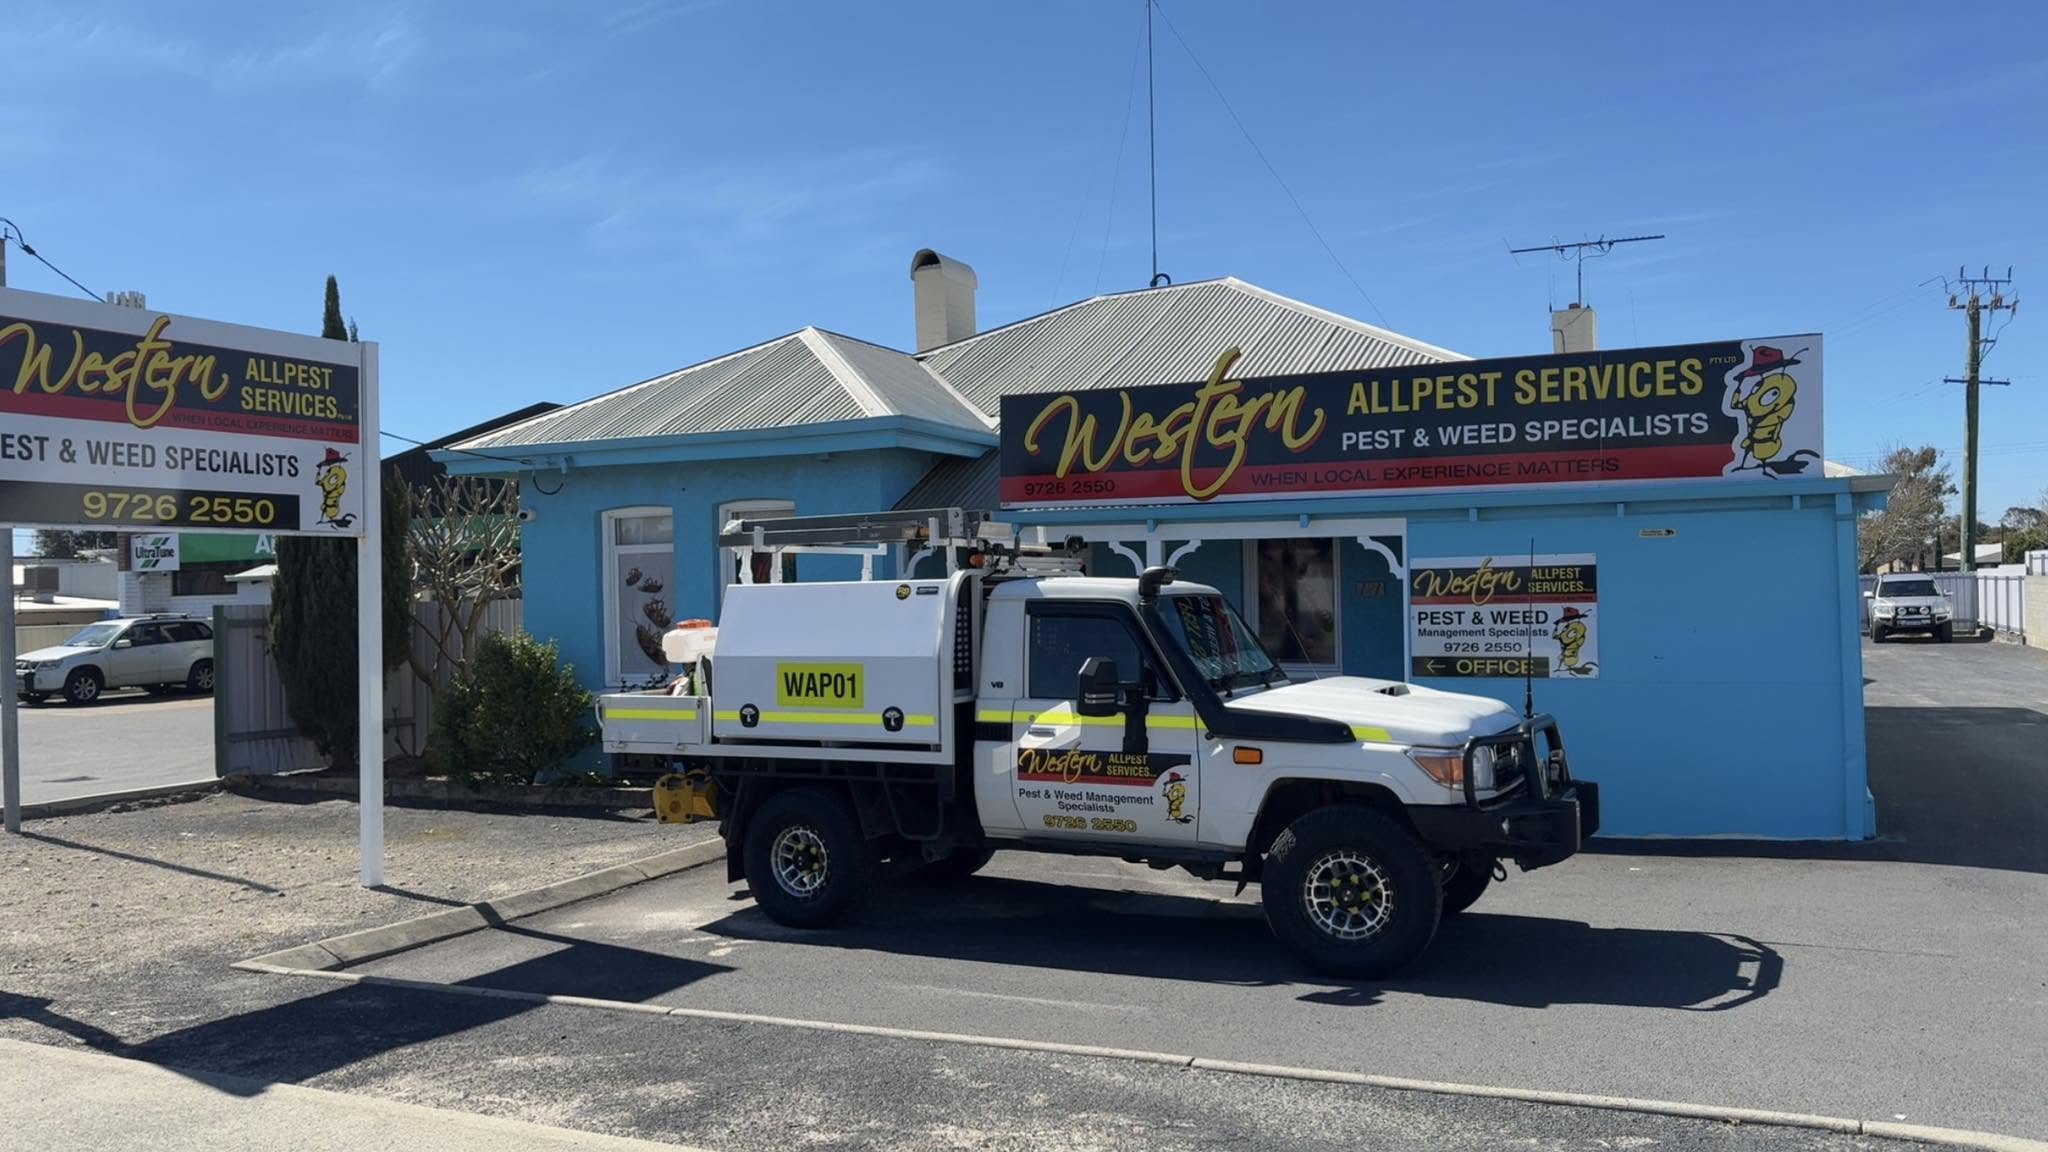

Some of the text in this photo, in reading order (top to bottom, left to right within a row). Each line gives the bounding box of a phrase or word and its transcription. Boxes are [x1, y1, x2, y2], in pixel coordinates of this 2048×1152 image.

[0, 315, 230, 429] Western
[245, 357, 333, 391] ALLPEST
[1345, 356, 1704, 416] ALLPEST SERVICES
[240, 385, 338, 420] SERVICES
[172, 413, 353, 439] WHEN LOCAL EXPERIENCE MATTERS
[1024, 345, 1328, 501] Western
[1341, 412, 1710, 452] PEST & WEED SPECIALISTS
[58, 438, 77, 463] &
[86, 439, 157, 469] WEED
[164, 445, 300, 478] SPECIALISTS
[1251, 456, 1620, 488] WHEN LOCAL EXPERIENCE MATTERS
[1024, 479, 1115, 496] 9726 2550
[82, 490, 276, 524] 9726 2550
[1413, 557, 1522, 606] Western
[1527, 580, 1585, 593] SERVICES
[1531, 567, 1581, 580] ALLPEST
[1417, 610, 1549, 625] PEST & WEED
[1417, 627, 1549, 639] Management Specialsts
[1443, 642, 1522, 652] 9726 2550
[1456, 659, 1534, 675] OFFICE
[784, 672, 856, 698] WAP01
[1019, 741, 1102, 784] Western
[1106, 765, 1150, 778] SERVICES
[1108, 753, 1148, 766] ALLPEST
[1018, 788, 1154, 805] Pest & Weed Management
[1057, 801, 1115, 813] Specialists
[1042, 814, 1138, 833] 9726 2550
